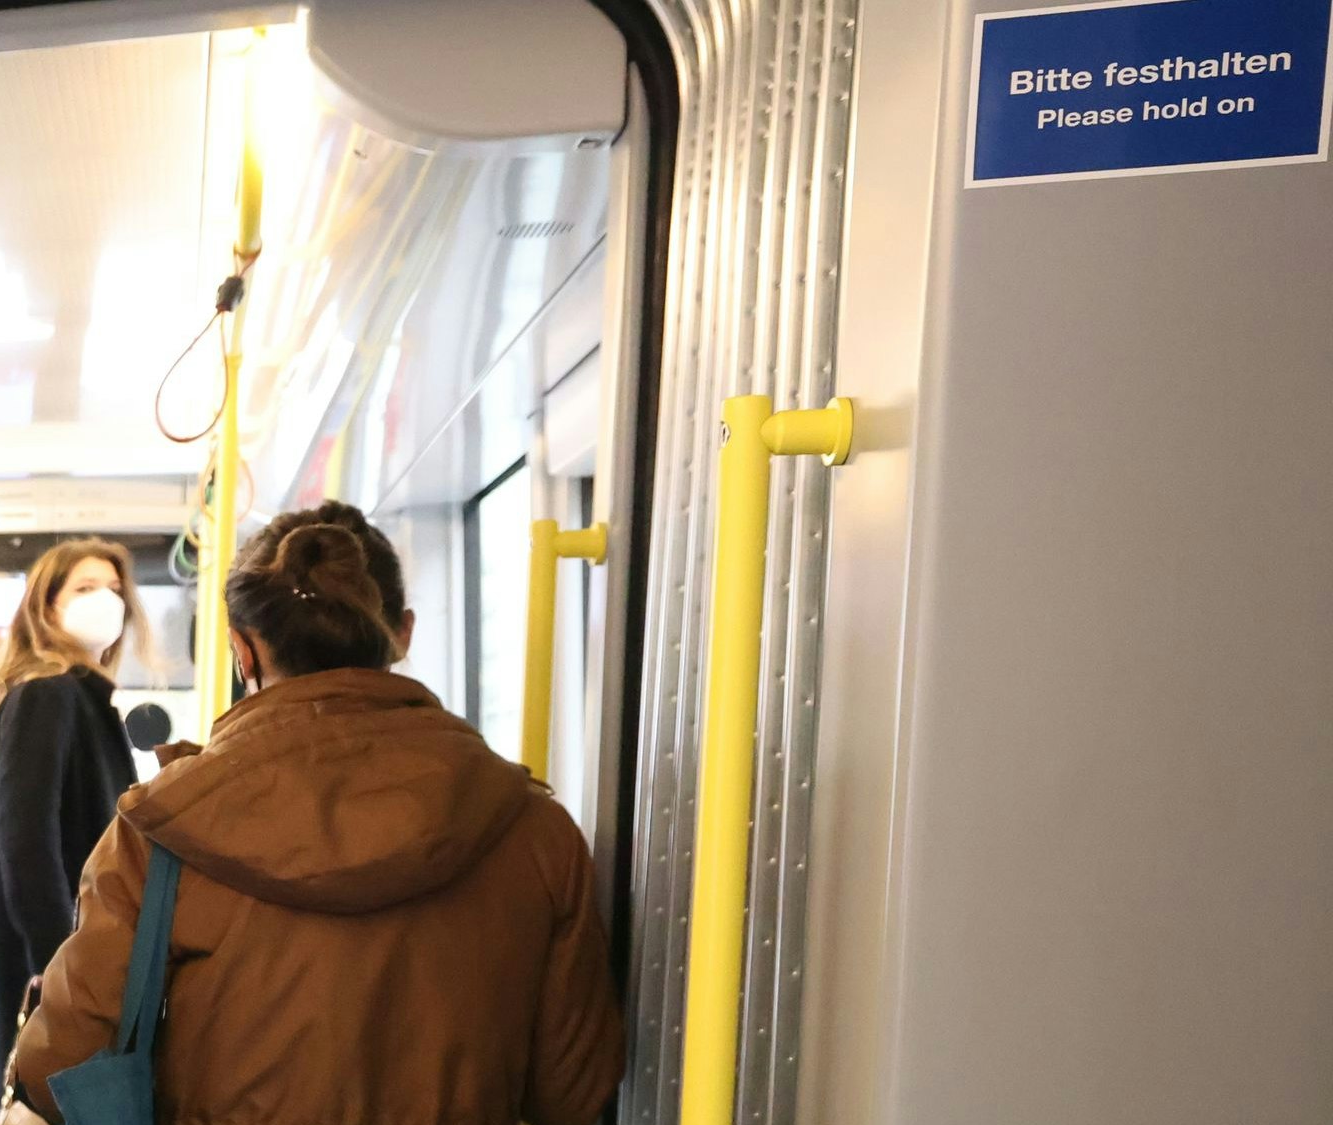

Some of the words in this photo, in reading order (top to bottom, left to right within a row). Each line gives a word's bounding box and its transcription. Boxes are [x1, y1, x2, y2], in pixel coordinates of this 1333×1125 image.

[1010, 70, 1093, 95] Bitte
[1104, 51, 1292, 87] festhalten
[1037, 107, 1133, 130] Please
[1142, 96, 1207, 121] hold
[1217, 96, 1255, 114] on
